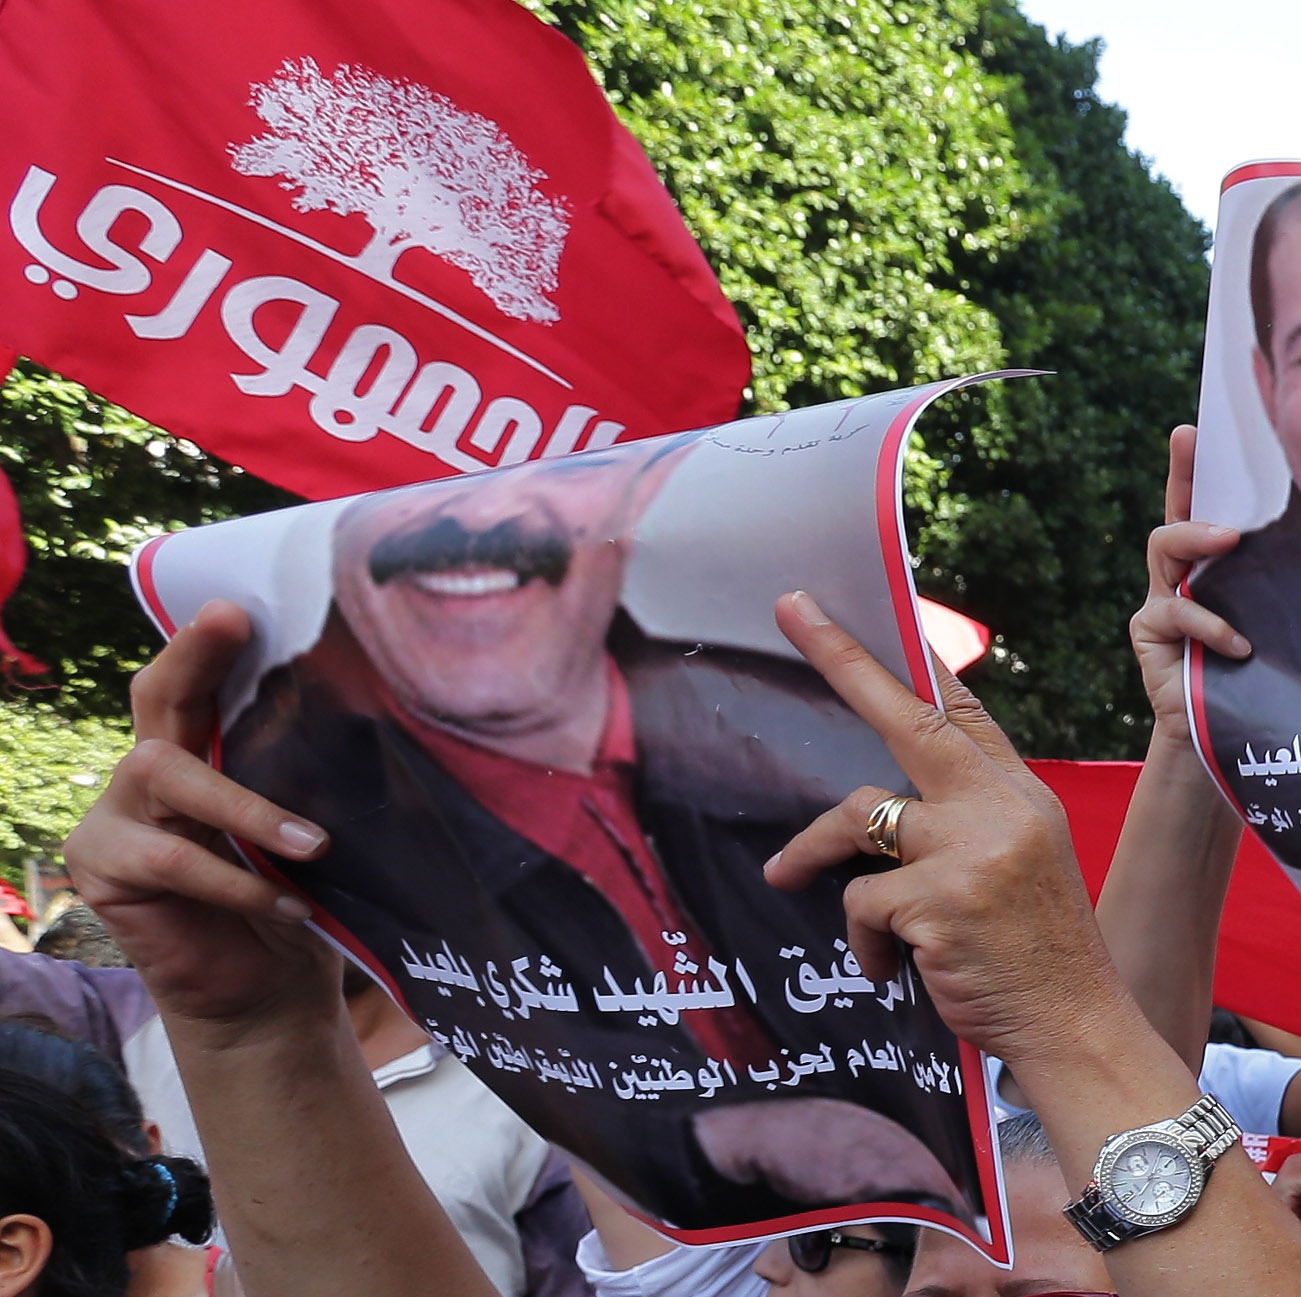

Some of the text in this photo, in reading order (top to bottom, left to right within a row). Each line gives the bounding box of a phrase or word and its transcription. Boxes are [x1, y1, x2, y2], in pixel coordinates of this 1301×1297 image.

[400, 938, 486, 1008] بلعيد
[483, 953, 581, 1022] شكري
[748, 1042, 836, 1092] لحزب
[846, 1038, 907, 1079] العام
